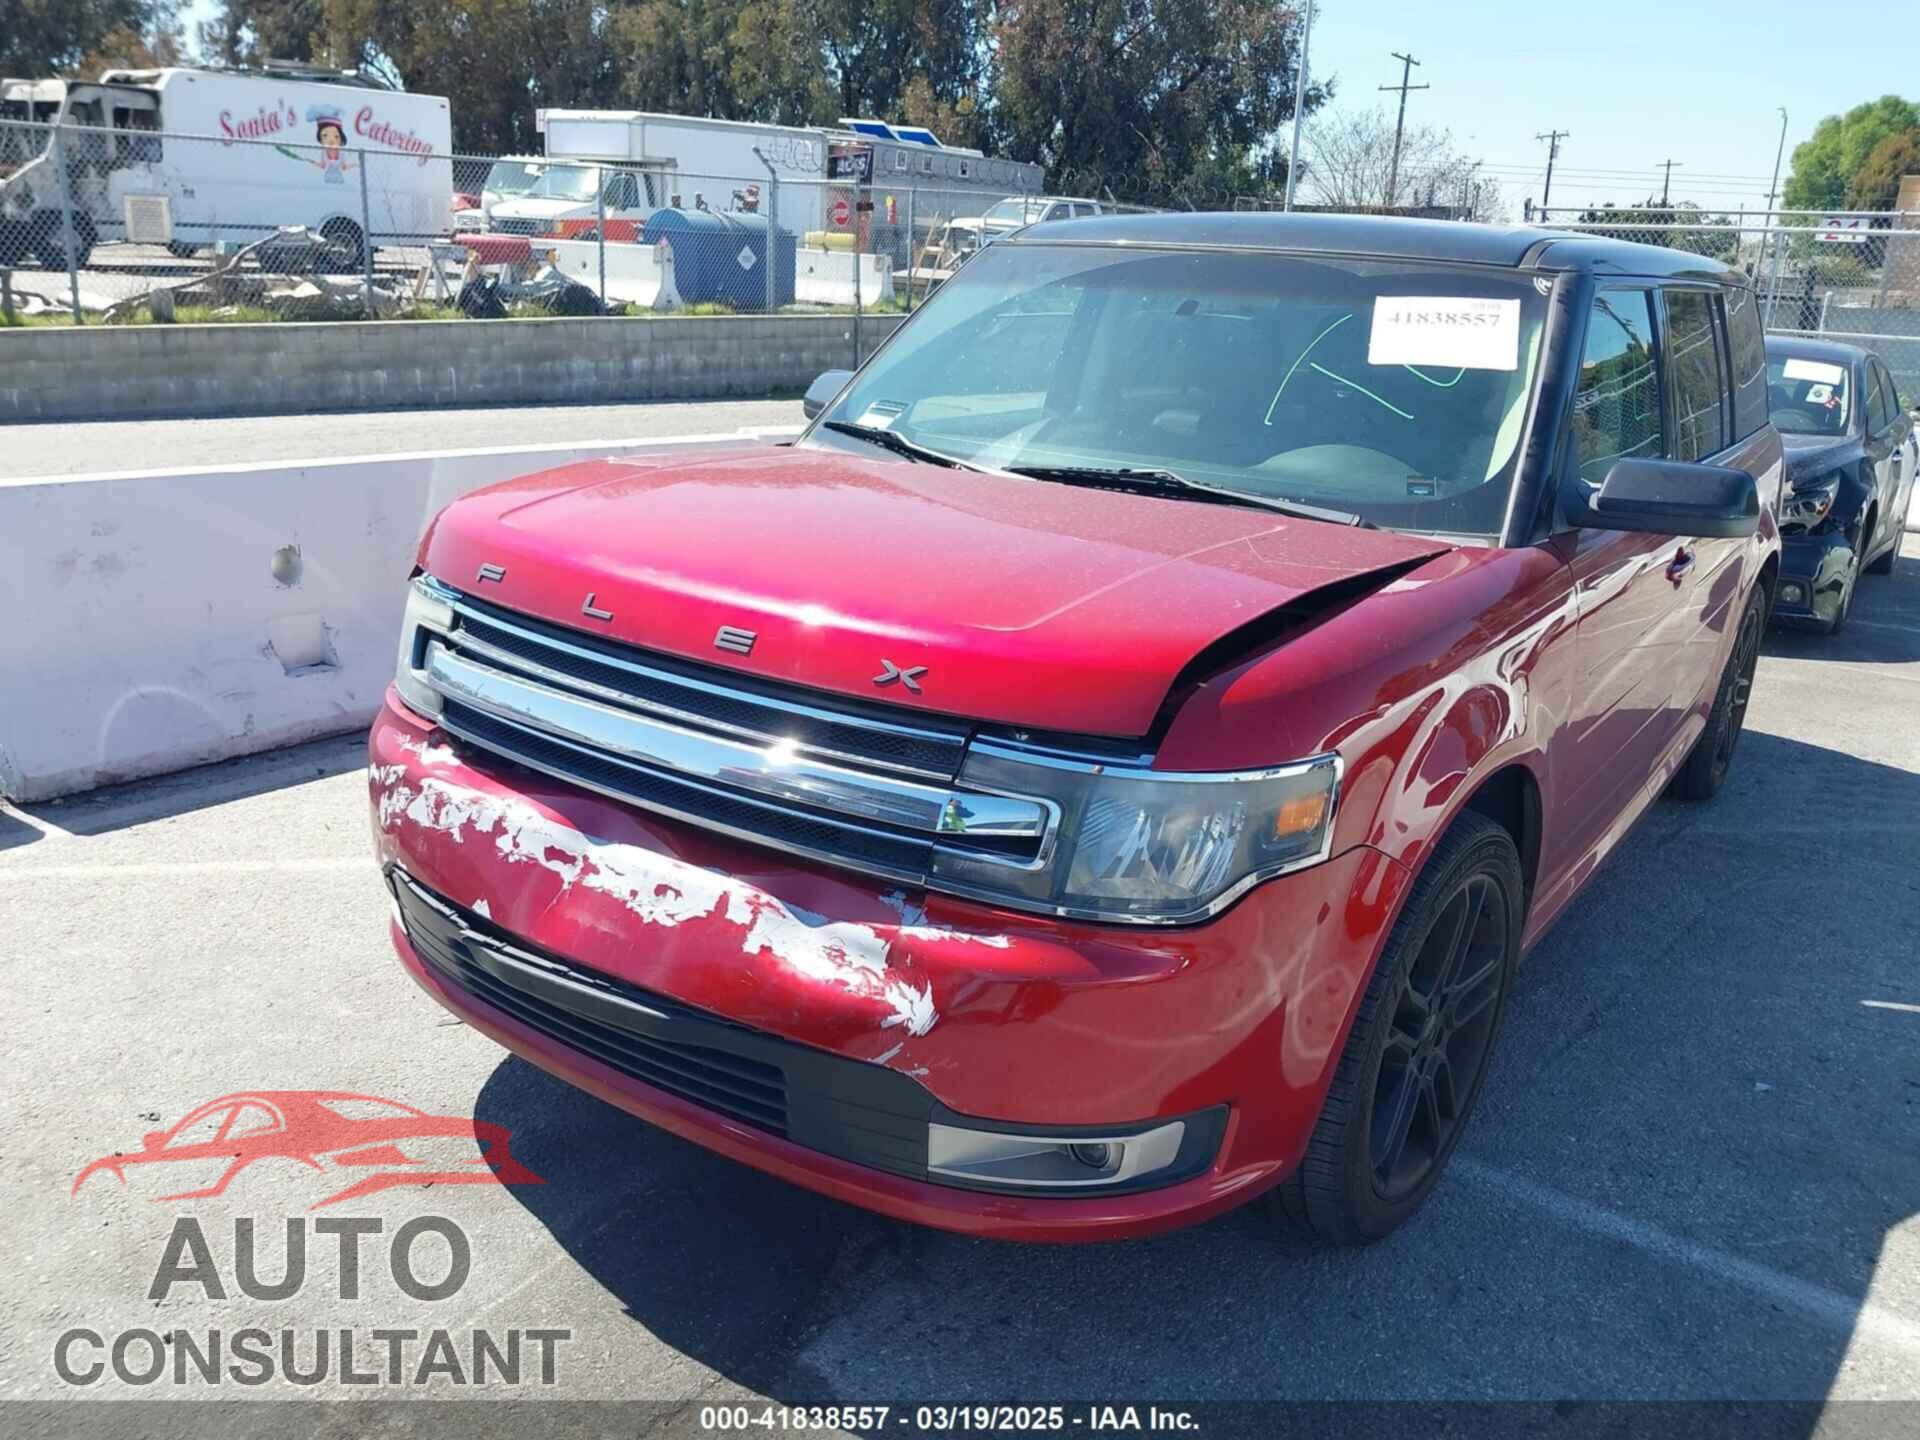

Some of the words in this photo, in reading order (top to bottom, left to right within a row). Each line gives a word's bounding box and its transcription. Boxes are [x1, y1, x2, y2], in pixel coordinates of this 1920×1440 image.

[219, 97, 297, 147] Sonia's
[354, 104, 434, 166] Catering
[1388, 311, 1501, 327] 41838557
[475, 562, 929, 693] FLEX
